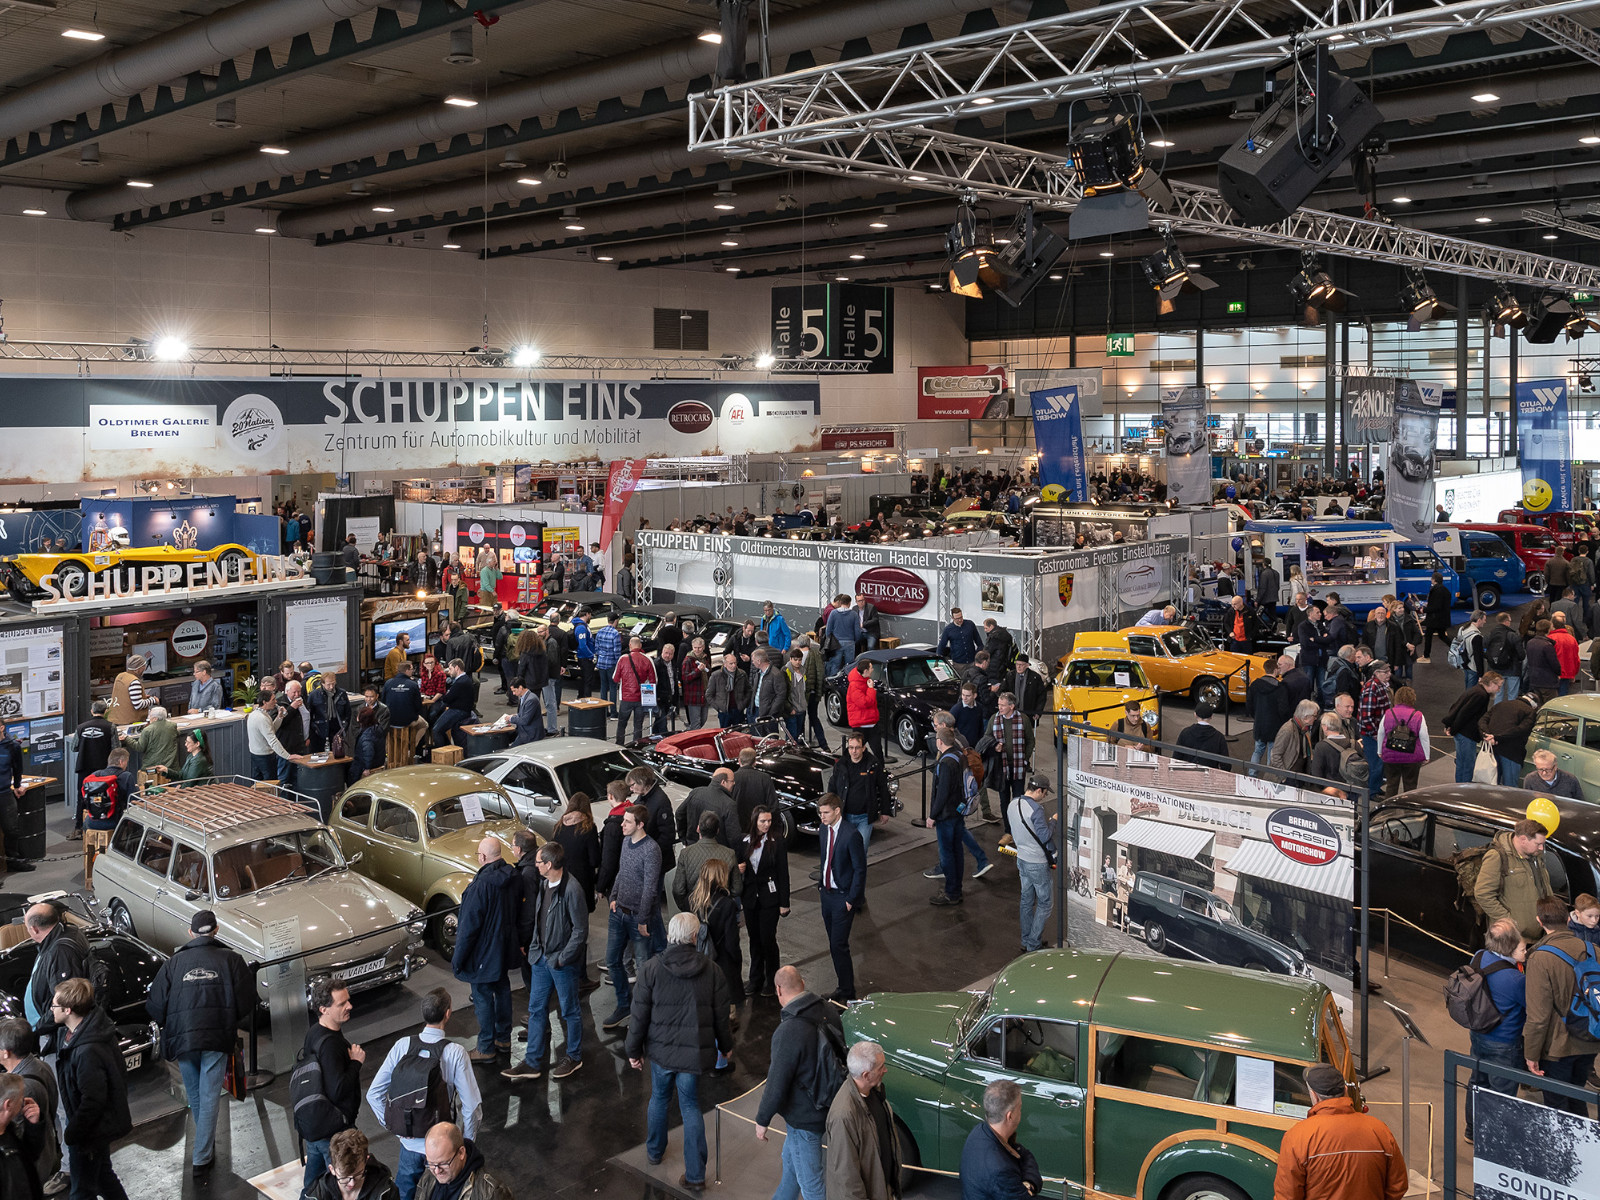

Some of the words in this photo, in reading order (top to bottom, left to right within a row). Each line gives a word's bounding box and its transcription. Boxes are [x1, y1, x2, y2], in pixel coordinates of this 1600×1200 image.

[776, 306, 791, 358] Halle
[802, 308, 825, 359] 5
[844, 304, 856, 357] Halle
[864, 309, 883, 358] 5
[930, 376, 995, 391] CC-Cars
[322, 381, 545, 425] SCHUPPEN
[564, 381, 642, 421] EINS
[98, 418, 159, 427] OLDTIMER
[162, 418, 210, 426] GALERIE
[671, 413, 711, 423] RETROCARS
[731, 409, 744, 420] AFL
[131, 429, 180, 437] BREMEN
[324, 433, 397, 452] Zentrum
[402, 431, 425, 449] für
[430, 428, 548, 449] Automobilkultur
[553, 429, 579, 445] und
[584, 427, 642, 445] Mobilität
[609, 460, 635, 503] fertan
[637, 532, 698, 551] SCHUPPEN
[703, 536, 732, 553] EINS
[740, 540, 811, 558] Oldtimerschau
[817, 545, 882, 563] Werkstätten
[889, 551, 929, 567] Handel
[936, 554, 973, 573] Shops
[1037, 554, 1089, 574] Gastronomie
[1093, 551, 1118, 566] Events
[1122, 542, 1170, 561] Einstellplätze
[665, 562, 677, 572] 231
[39, 558, 228, 604] SCHUPPEN
[238, 552, 308, 583] EINS
[860, 582, 925, 600] RETROCARS
[293, 597, 326, 606] SCHUPPEN
[36, 625, 54, 633] EINS
[181, 626, 200, 634] ZOLL
[177, 643, 203, 652] DOUANE
[1075, 773, 1129, 794] SONDERSCHAU:
[1129, 787, 1195, 812] KOMBI-NATIONEN
[1288, 815, 1318, 831] BREMEN
[1271, 824, 1336, 848] CLASSIC
[1281, 840, 1326, 860] MOTORSHOW
[348, 959, 384, 977] VARIANT
